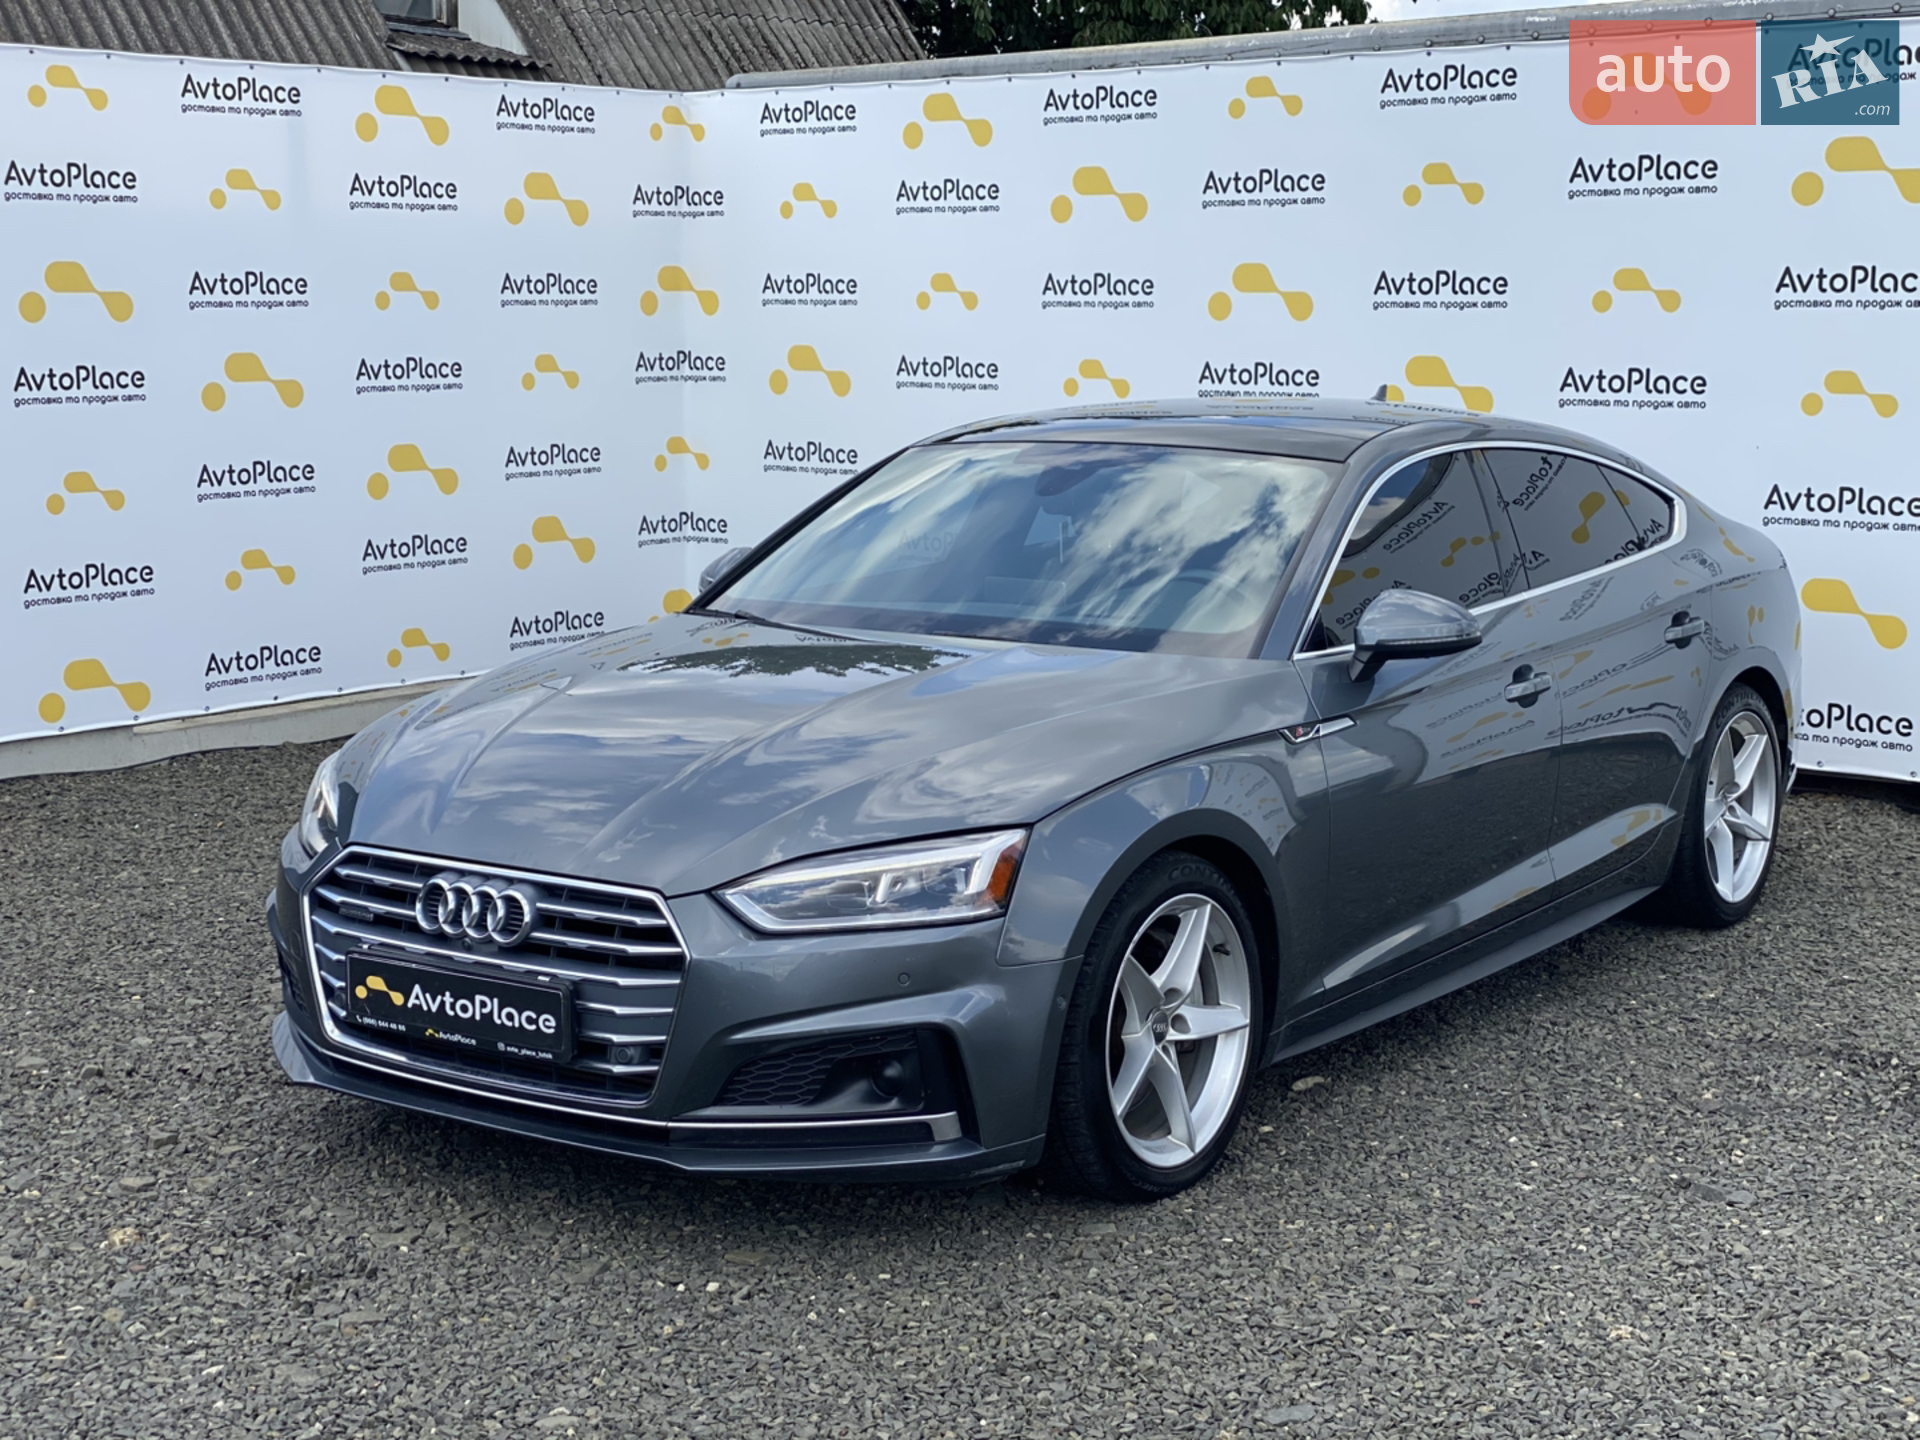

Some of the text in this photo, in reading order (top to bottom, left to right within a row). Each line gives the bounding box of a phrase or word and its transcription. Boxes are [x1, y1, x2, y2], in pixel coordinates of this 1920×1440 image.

[180, 73, 301, 105] AvtoPlace
[1380, 63, 1518, 94] AvtoPlace
[180, 103, 302, 118] доставка та продаж авто
[496, 94, 595, 123] AvtoPlace
[1043, 84, 1158, 112] AvtoPlace
[1379, 92, 1517, 110] доставка та продаж авто
[760, 99, 857, 125] AvtoPlace
[3, 159, 137, 190] AvtoPlace
[1569, 153, 1719, 184] AvtoPlace
[349, 172, 458, 200] AvtoPlace
[896, 178, 1000, 202] AvtoPlace
[1202, 168, 1326, 195] AvtoPlace
[1567, 185, 1718, 200] доставка та продаж авто
[4, 191, 138, 205] доставка та продаж авто
[632, 184, 724, 207] AvtoPlace
[1201, 197, 1326, 210] доставка та продаж авто
[188, 270, 308, 296] AvtoPlace
[500, 272, 598, 295] AvtoPlace
[762, 272, 858, 295] AvtoPlace
[1042, 272, 1155, 296] AvtoPlace
[1373, 269, 1509, 296] AvtoPlace
[188, 300, 309, 311] доставка та продаж авто
[1372, 300, 1508, 311] доставка та продаж авто
[1773, 299, 1903, 311] доставка та продаж
[355, 356, 463, 381] AvtoPlace
[635, 350, 726, 372] AvtoPlace
[896, 354, 999, 380] AvtoPlace
[13, 364, 146, 393] AvtoPlace
[1198, 361, 1320, 388] AvtoPlace
[1559, 366, 1707, 396] AvtoPlace
[13, 394, 147, 408] доставка та продаж авто
[1558, 398, 1707, 411] доставка та продаж авто
[505, 443, 601, 468] AvtoPlace
[763, 439, 858, 465] AvtoPlace
[196, 460, 315, 489] AvtoPlace
[196, 485, 316, 503] доставка та продаж авто
[638, 511, 728, 536] AvtoPlace
[1762, 516, 1820, 527] доставка
[1822, 519, 1841, 528] та
[1843, 520, 1890, 532] продаж
[362, 534, 468, 562] AvtoPlace
[23, 562, 154, 595] AvtoPlace
[23, 587, 155, 610] доставка та продаж авто
[509, 610, 605, 639] AvtoPlace
[204, 644, 322, 677] AvtoPlace
[204, 666, 322, 692] доставка та продаж авто
[407, 983, 557, 1034] AvtoPlace
[439, 1031, 477, 1046] AvtoPlace
